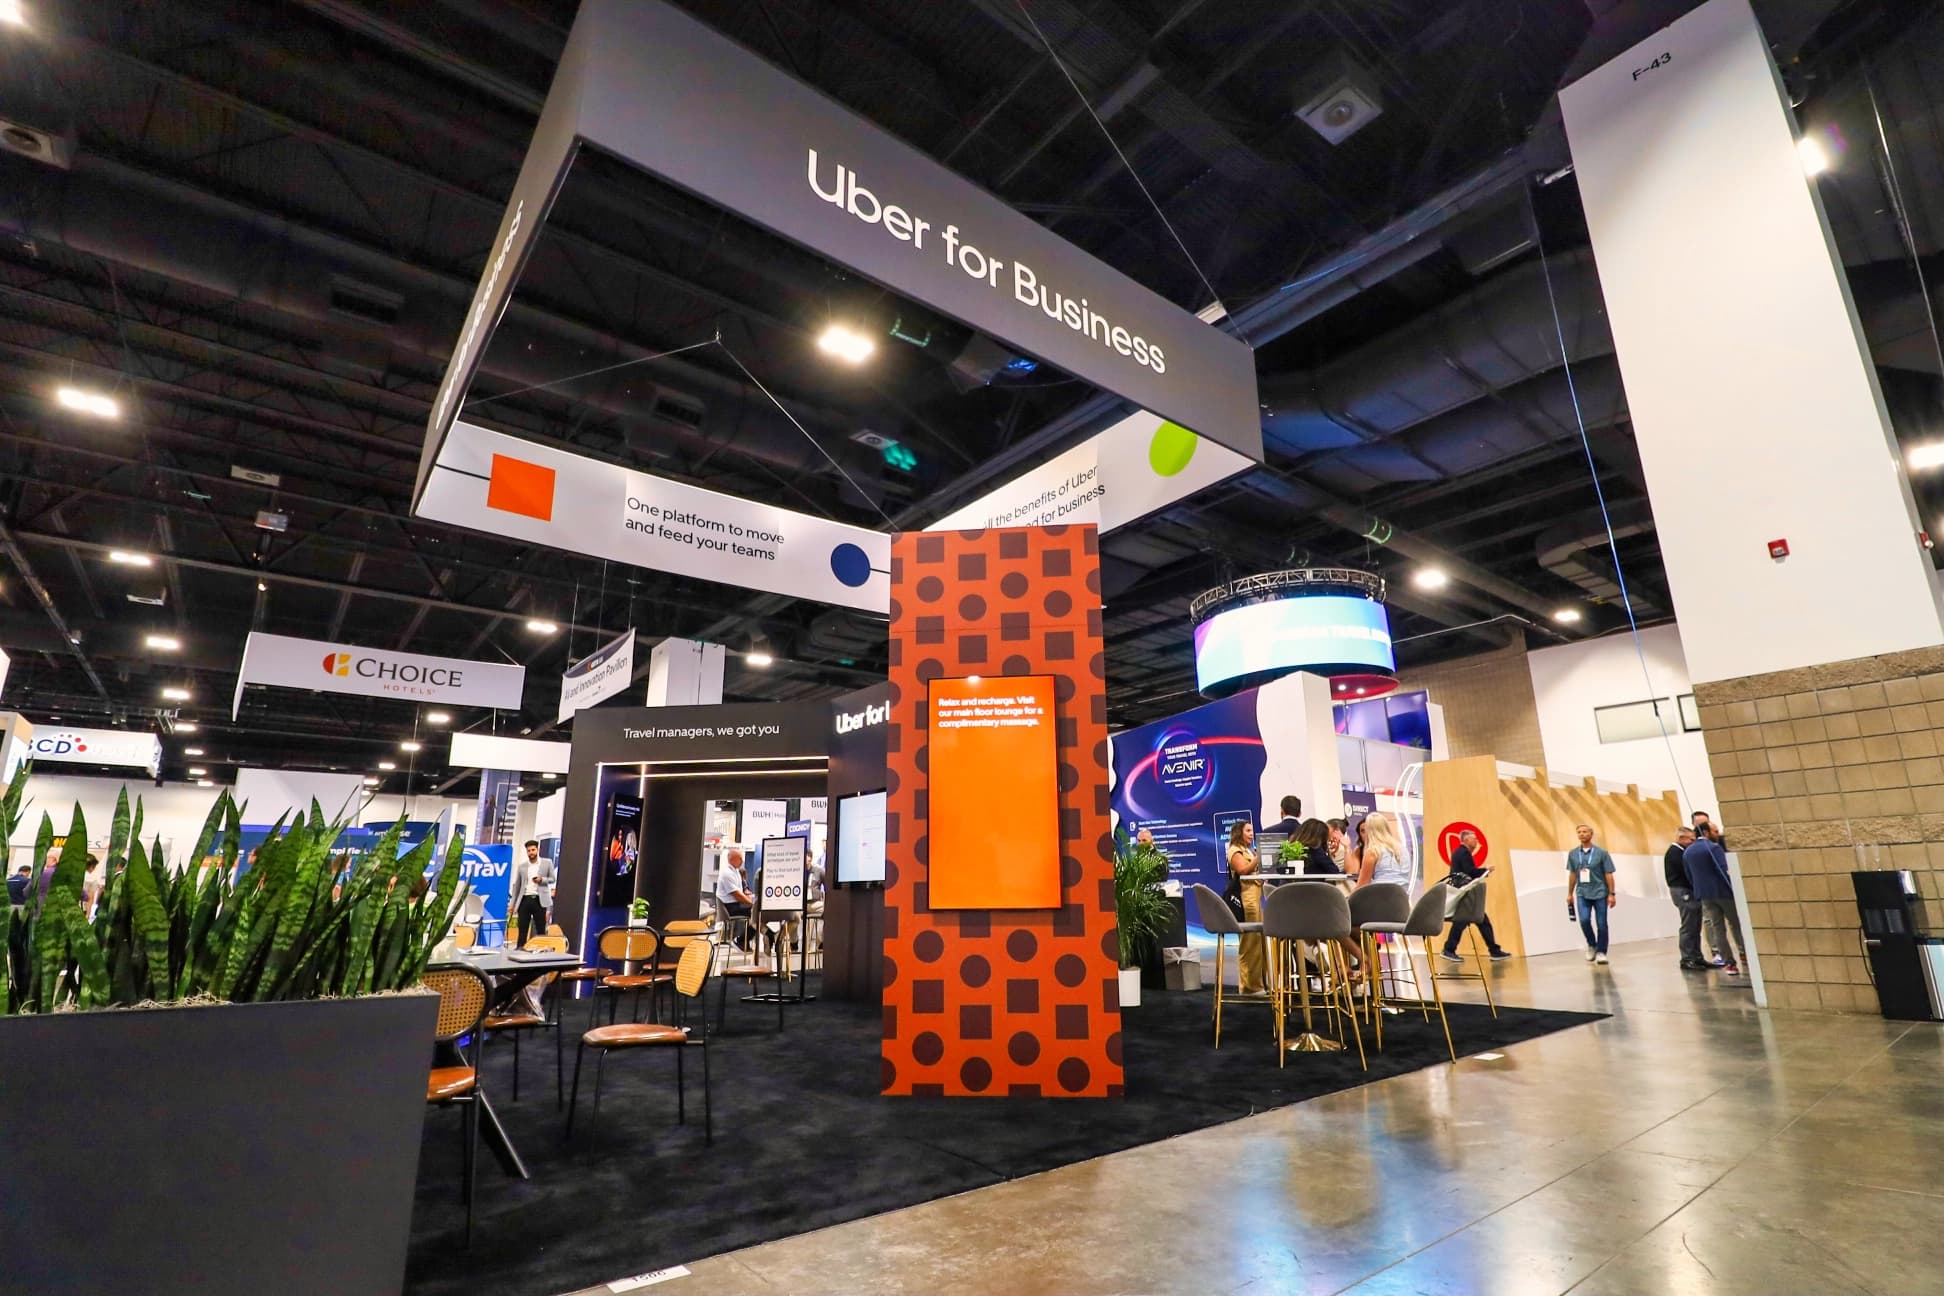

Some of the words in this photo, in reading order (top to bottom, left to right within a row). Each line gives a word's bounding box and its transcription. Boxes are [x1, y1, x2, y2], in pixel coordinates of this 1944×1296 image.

[1632, 52, 1671, 81] F-43
[808, 148, 930, 249] Uber
[941, 225, 1003, 288] for
[1013, 261, 1166, 374] Business
[996, 512, 1012, 527] the
[1014, 490, 1057, 518] benefits
[1058, 480, 1070, 496] of
[1071, 465, 1098, 488] Uber
[1041, 509, 1056, 524] for
[1058, 483, 1106, 517] business
[627, 497, 660, 517] One
[663, 508, 725, 533] platform
[728, 523, 743, 537] to
[746, 528, 785, 544] move
[625, 518, 655, 535] and
[658, 524, 693, 545] feed
[696, 535, 729, 552] your
[732, 542, 776, 561] teams
[356, 658, 463, 687] CHOICE
[606, 657, 628, 676] Pavilion
[938, 697, 960, 706] Relax
[961, 697, 977, 706] and
[1016, 696, 1035, 704] Visit
[953, 708, 974, 717] main
[974, 707, 993, 716] floor
[994, 707, 1024, 717] lounge
[1024, 706, 1037, 714] for
[624, 727, 656, 739] Travel
[656, 726, 715, 740] managers,
[717, 726, 734, 736] we
[736, 724, 757, 738] got
[758, 725, 780, 737] you
[836, 713, 865, 734] Uber
[866, 704, 885, 726] for
[1162, 759, 1204, 775] AVENIR
